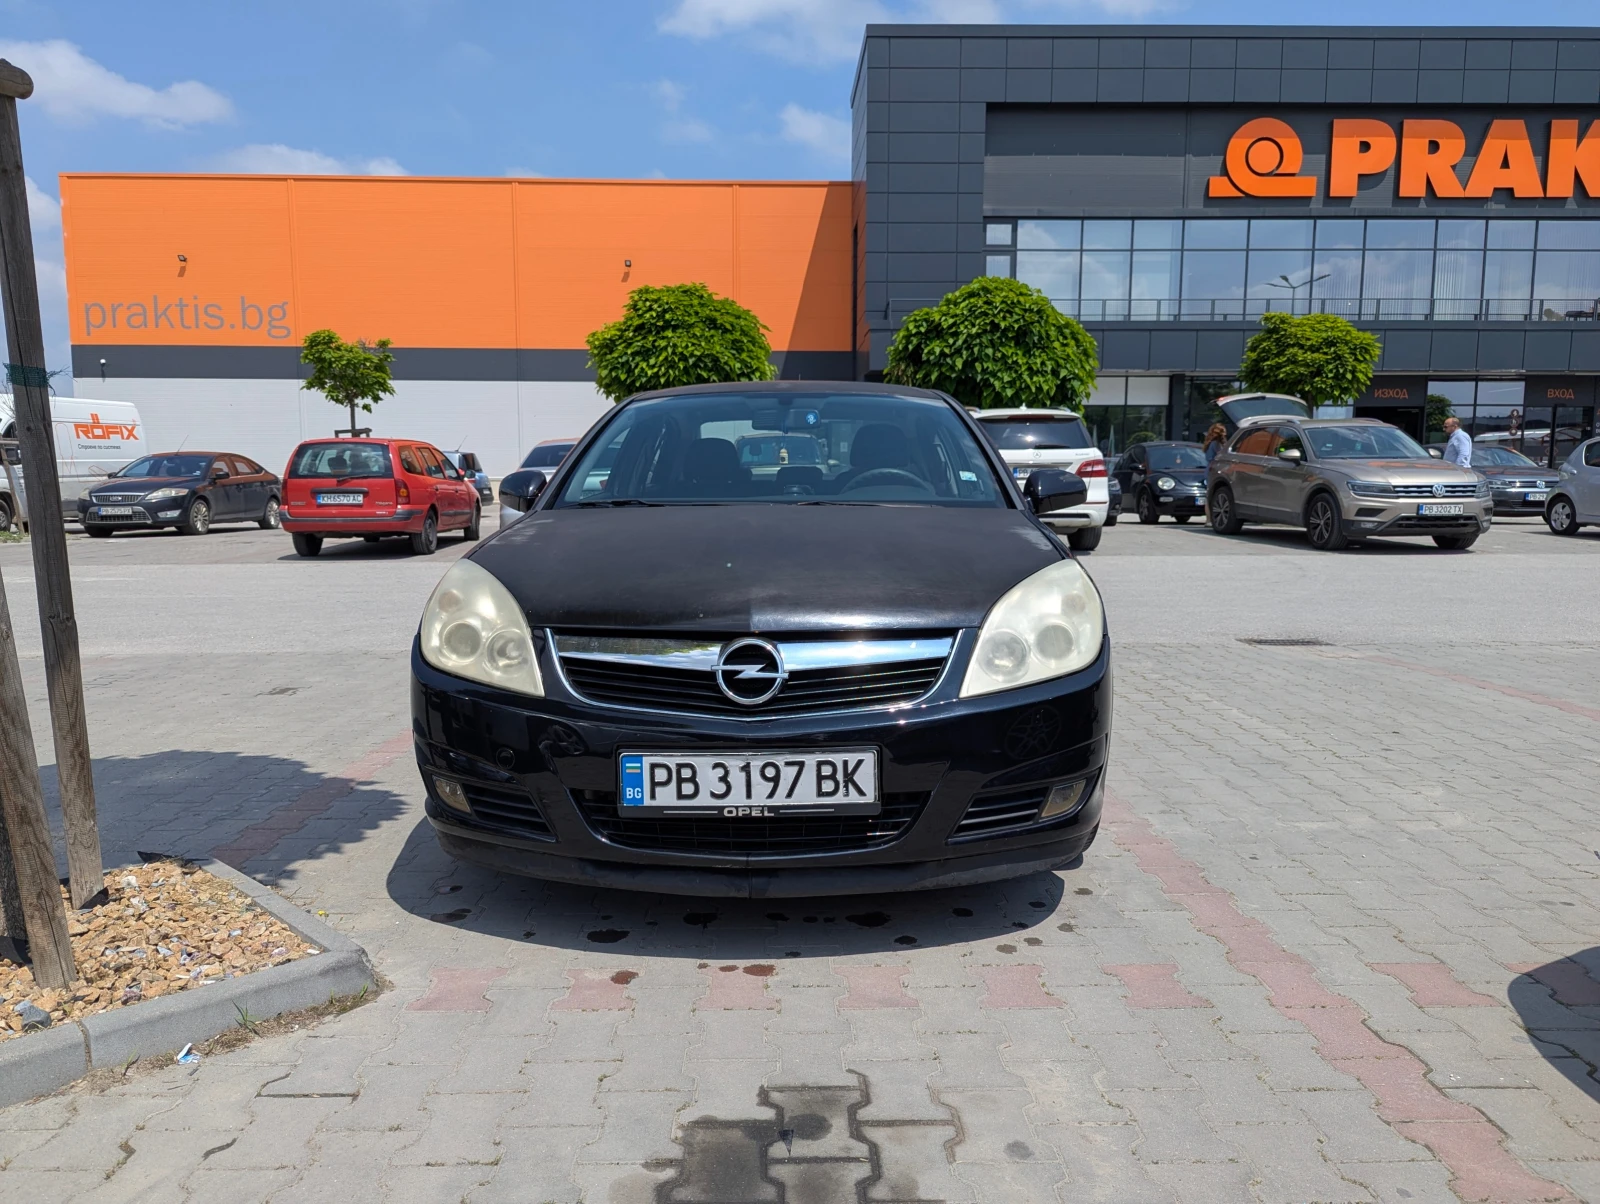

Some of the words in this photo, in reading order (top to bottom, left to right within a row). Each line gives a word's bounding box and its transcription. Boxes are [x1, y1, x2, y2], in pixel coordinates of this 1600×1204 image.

[1329, 118, 1600, 198] PRAK
[84, 295, 292, 340] praktis.bg
[1374, 388, 1409, 399] ИЗХОД
[1547, 388, 1575, 399] ВХОД
[1424, 505, 1434, 514] PB
[1434, 505, 1452, 514] 3202
[1453, 505, 1462, 514] TX
[649, 761, 700, 801] PB
[709, 760, 806, 801] 3197
[815, 758, 868, 799] BK
[626, 787, 643, 799] BG
[723, 806, 775, 817] OPEL
